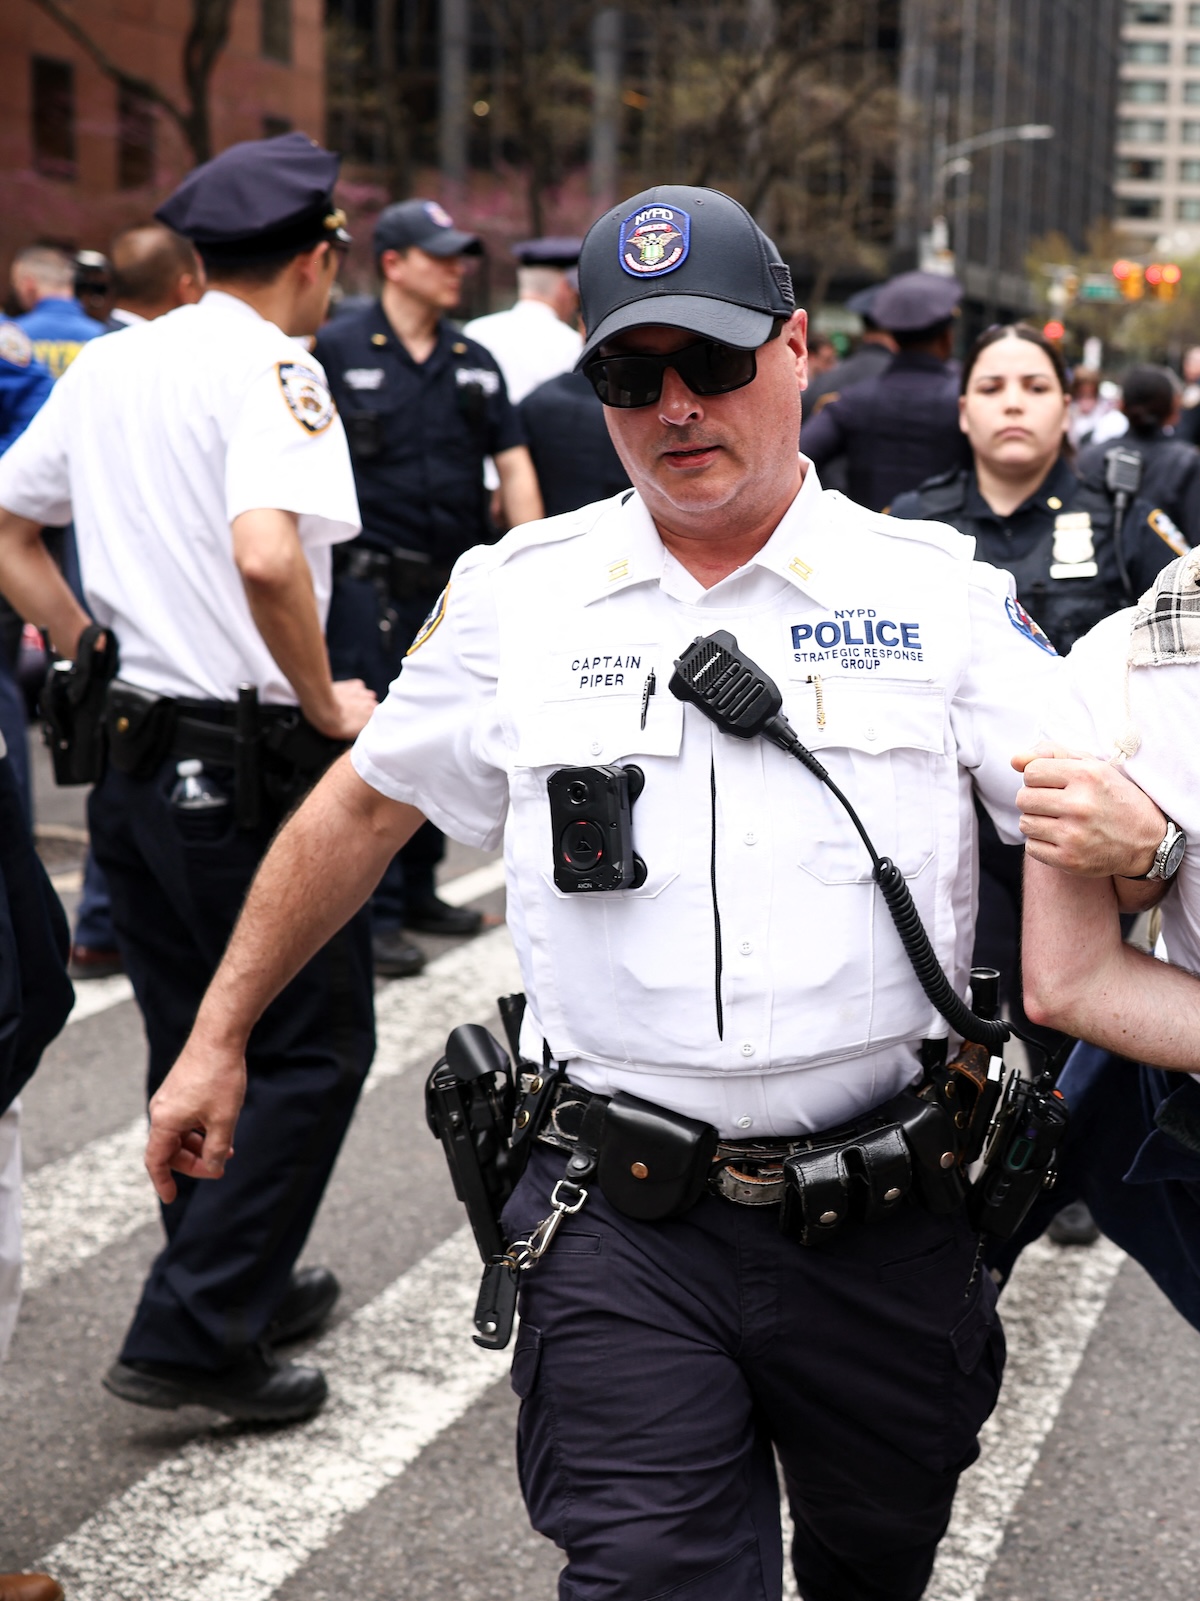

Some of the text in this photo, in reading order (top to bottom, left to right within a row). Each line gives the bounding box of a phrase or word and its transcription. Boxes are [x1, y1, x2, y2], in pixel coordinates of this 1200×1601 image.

[635, 207, 674, 225] NYPD
[834, 608, 877, 619] NYPD
[790, 620, 922, 650] POLICE
[571, 655, 641, 671] CAPTAIN
[794, 648, 924, 662] STRATEGIC RESPONSE
[692, 652, 722, 683] MOTOROLA
[841, 658, 881, 670] GROUP
[580, 673, 625, 689] PIPER
